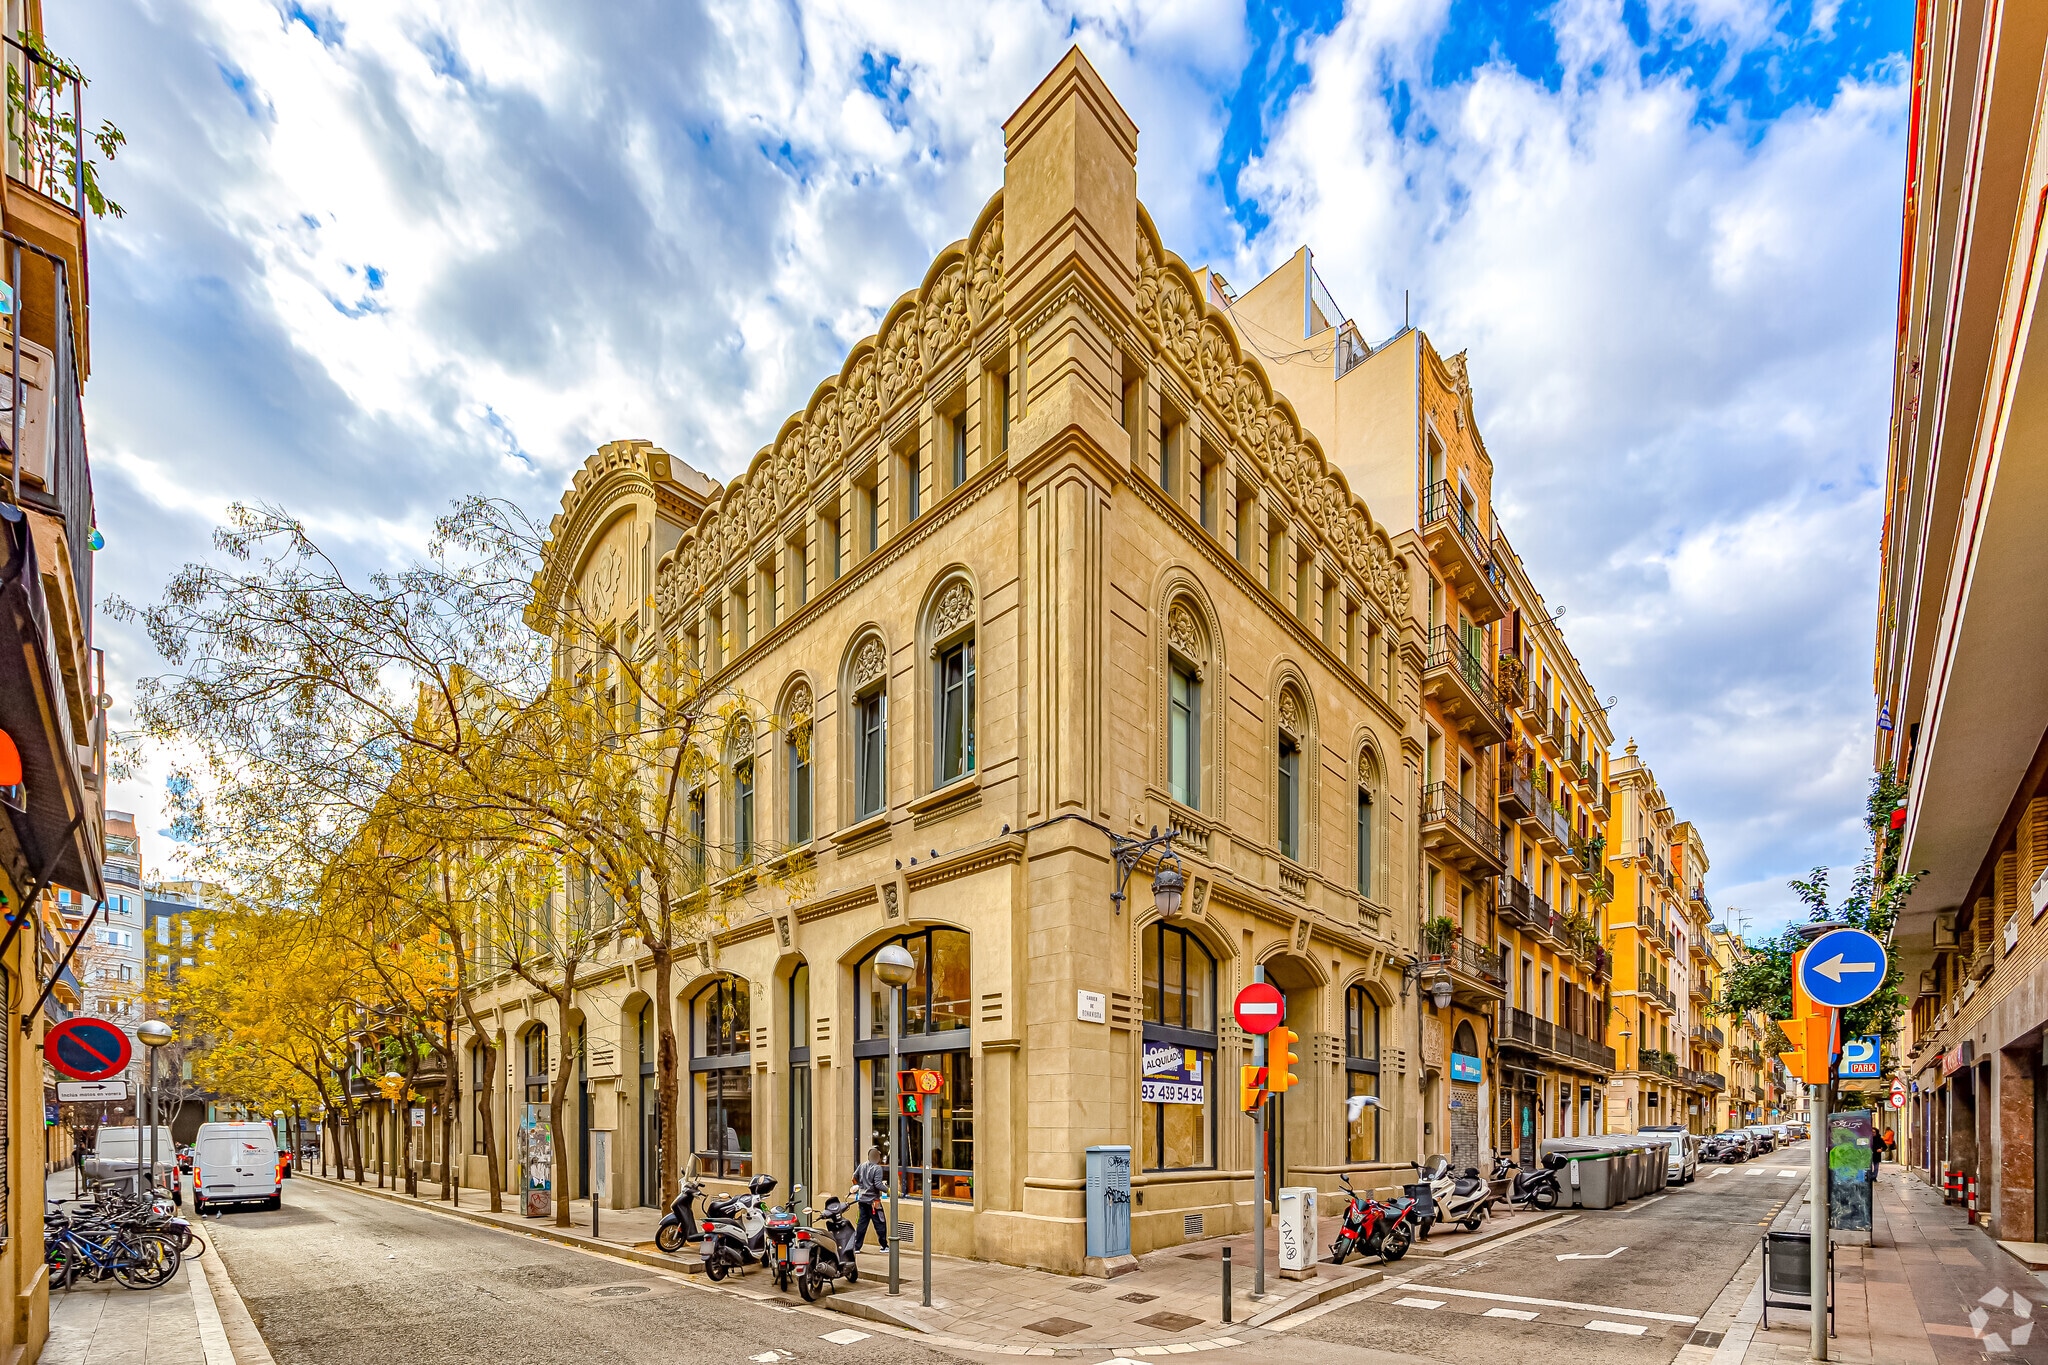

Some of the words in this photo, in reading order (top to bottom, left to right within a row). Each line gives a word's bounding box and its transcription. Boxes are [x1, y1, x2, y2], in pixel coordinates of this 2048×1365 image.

[1146, 1052, 1182, 1070] ALQUILADO
[1839, 1040, 1874, 1074] P
[1142, 1084, 1155, 1100] 93
[1158, 1085, 1175, 1101] 439
[1177, 1086, 1189, 1101] 54
[1191, 1087, 1203, 1102] 54
